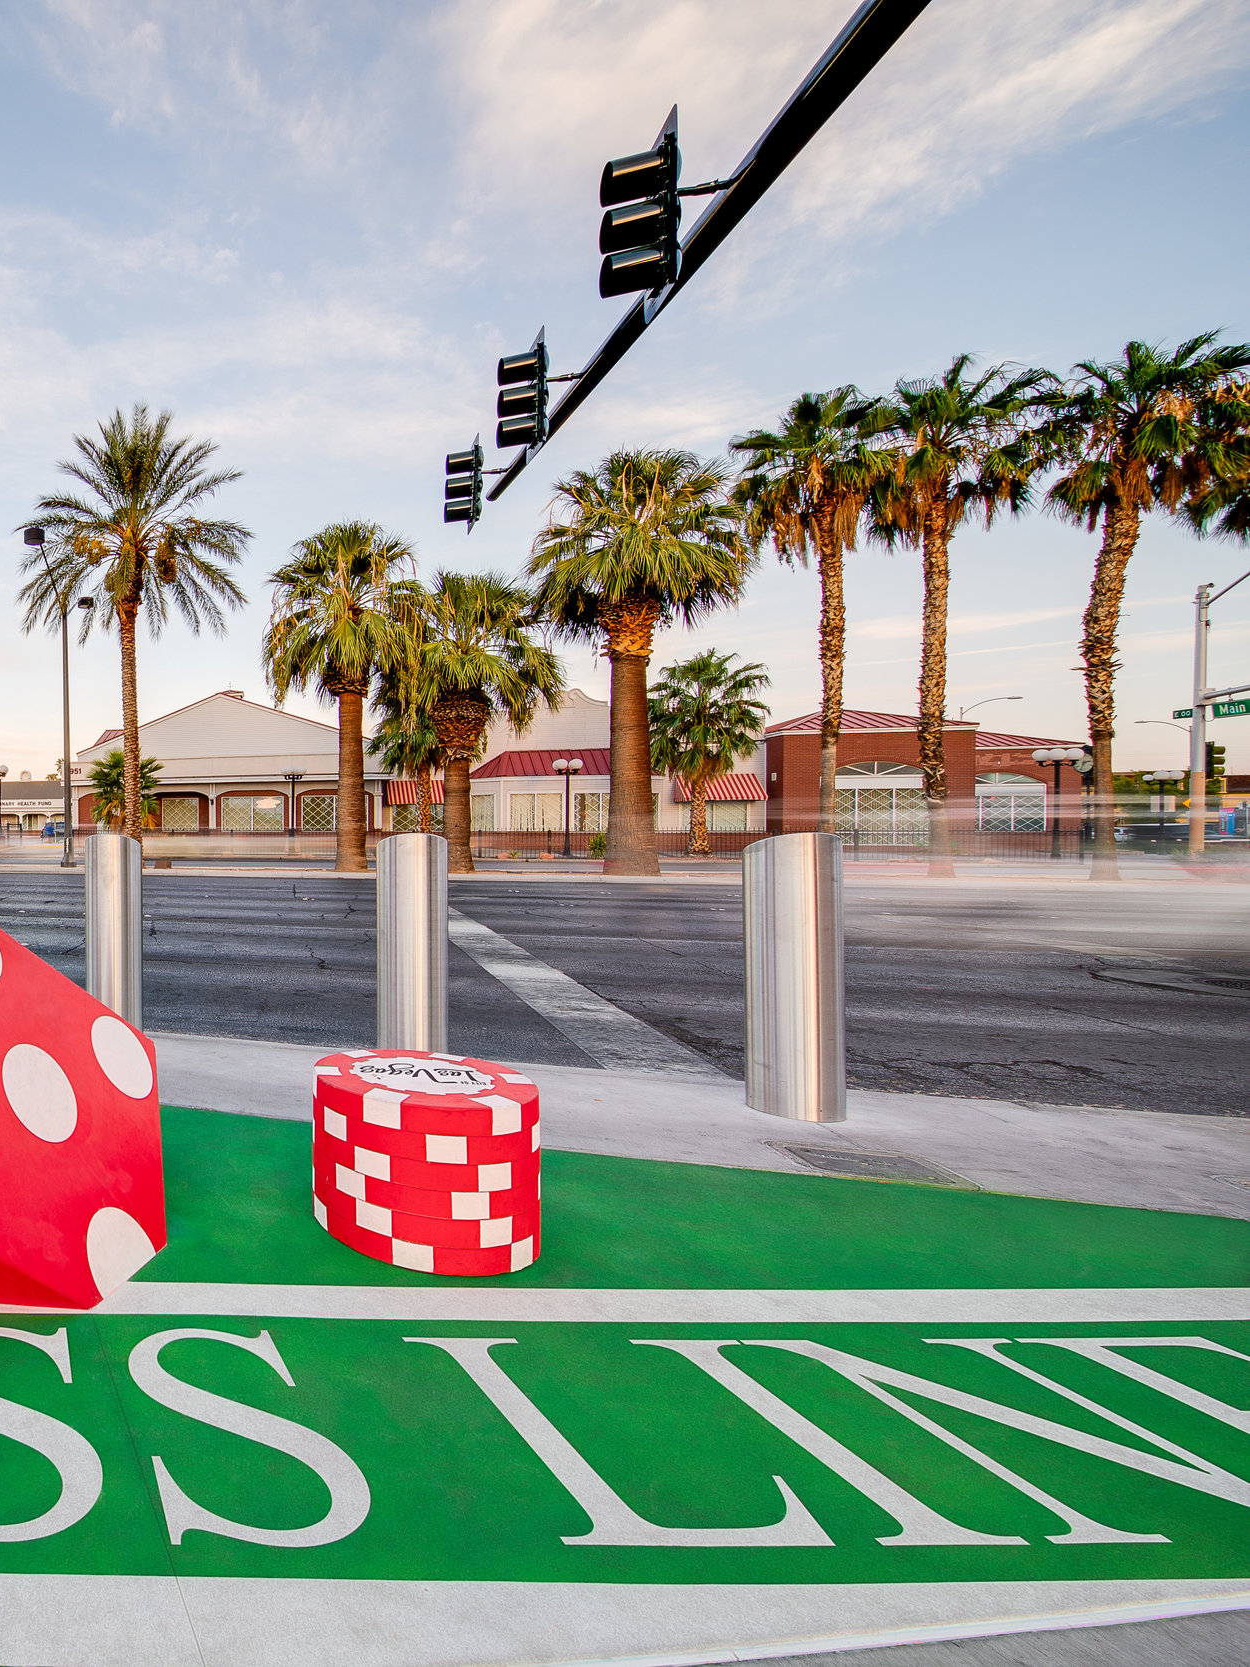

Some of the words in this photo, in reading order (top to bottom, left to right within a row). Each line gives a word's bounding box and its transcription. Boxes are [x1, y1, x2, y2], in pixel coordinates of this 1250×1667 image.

[1219, 703, 1247, 715] Main
[359, 1063, 458, 1083] Vegas
[433, 1068, 479, 1083] Las
